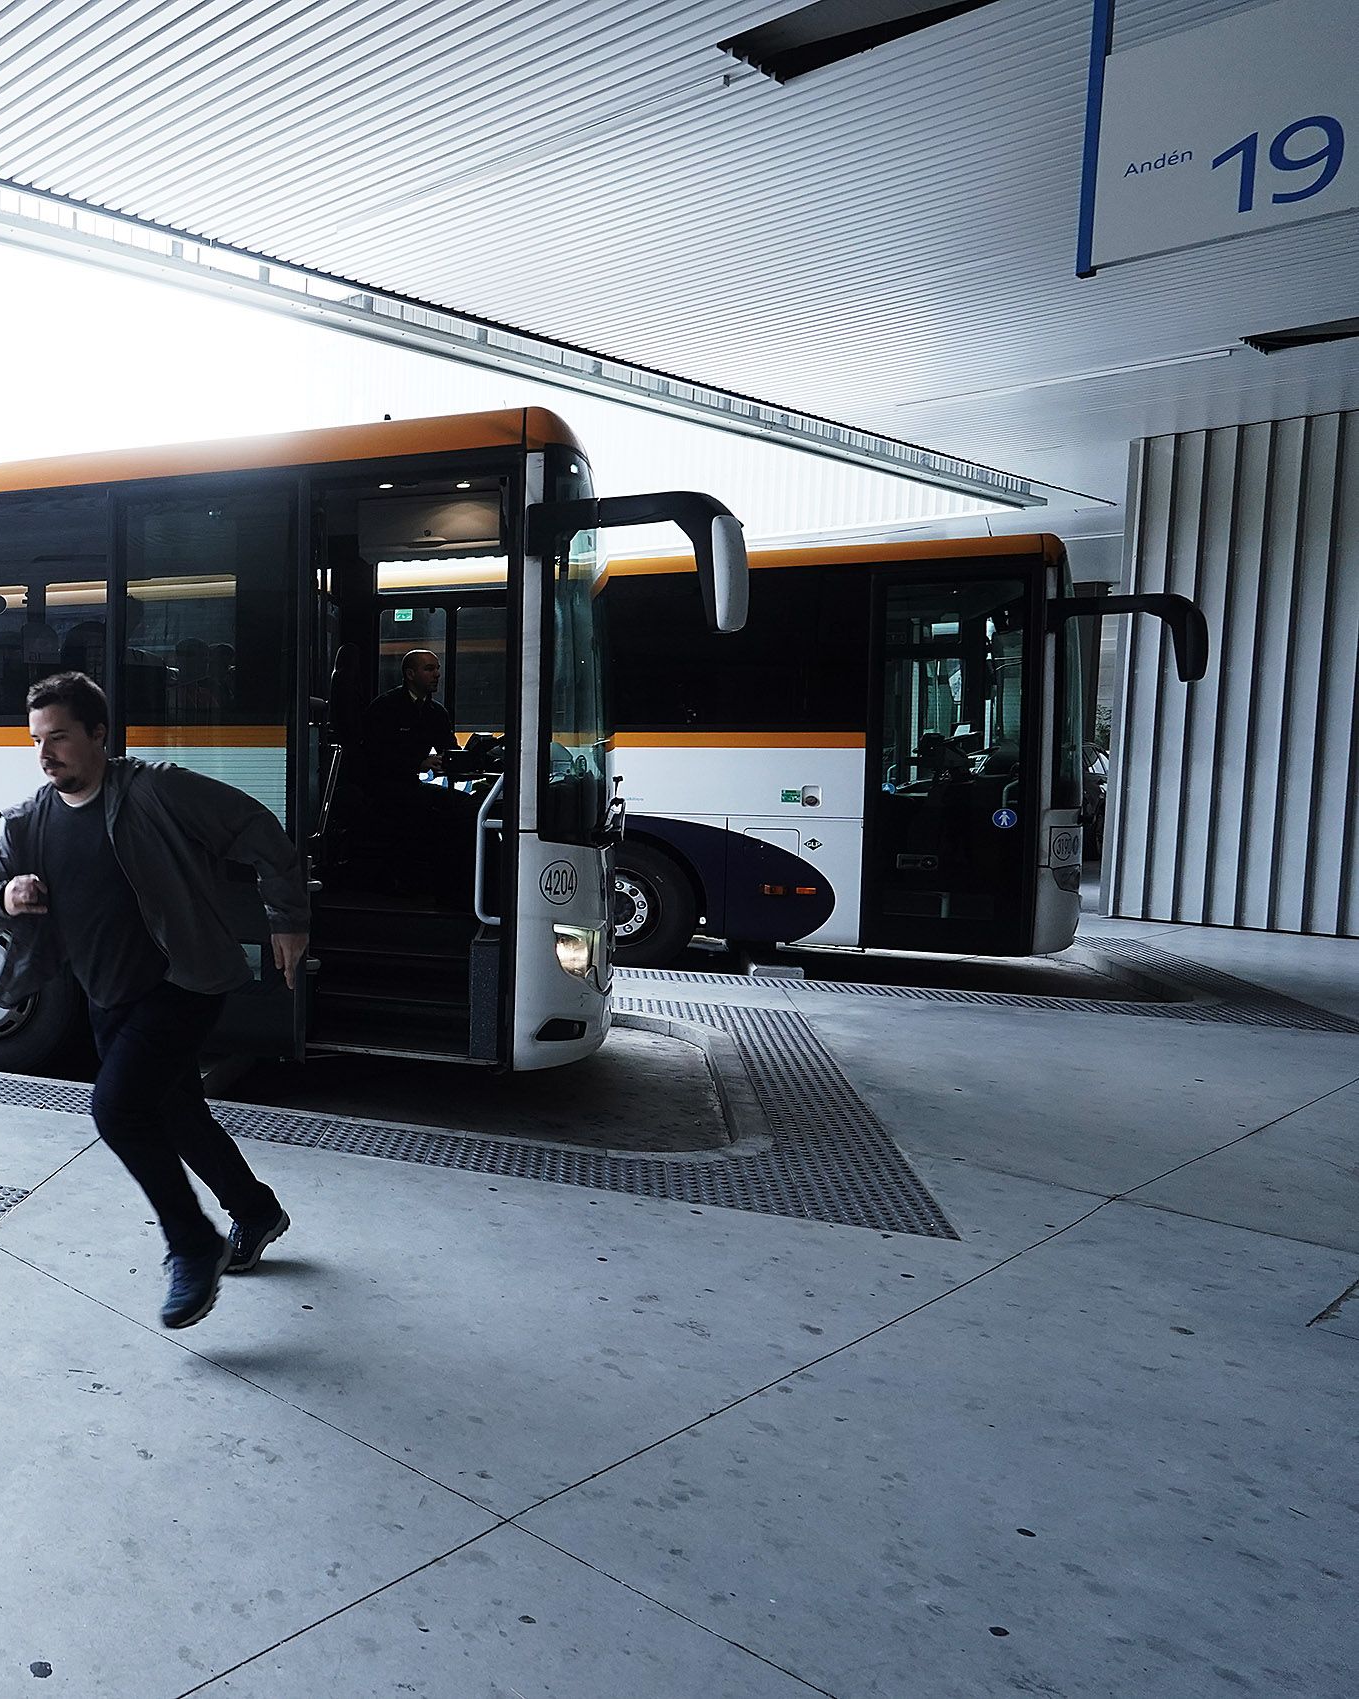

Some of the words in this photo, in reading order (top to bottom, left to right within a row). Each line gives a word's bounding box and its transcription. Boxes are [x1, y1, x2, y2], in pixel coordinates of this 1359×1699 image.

[1123, 149, 1193, 178] Andén
[1211, 115, 1345, 213] 19
[544, 869, 574, 895] 4204
